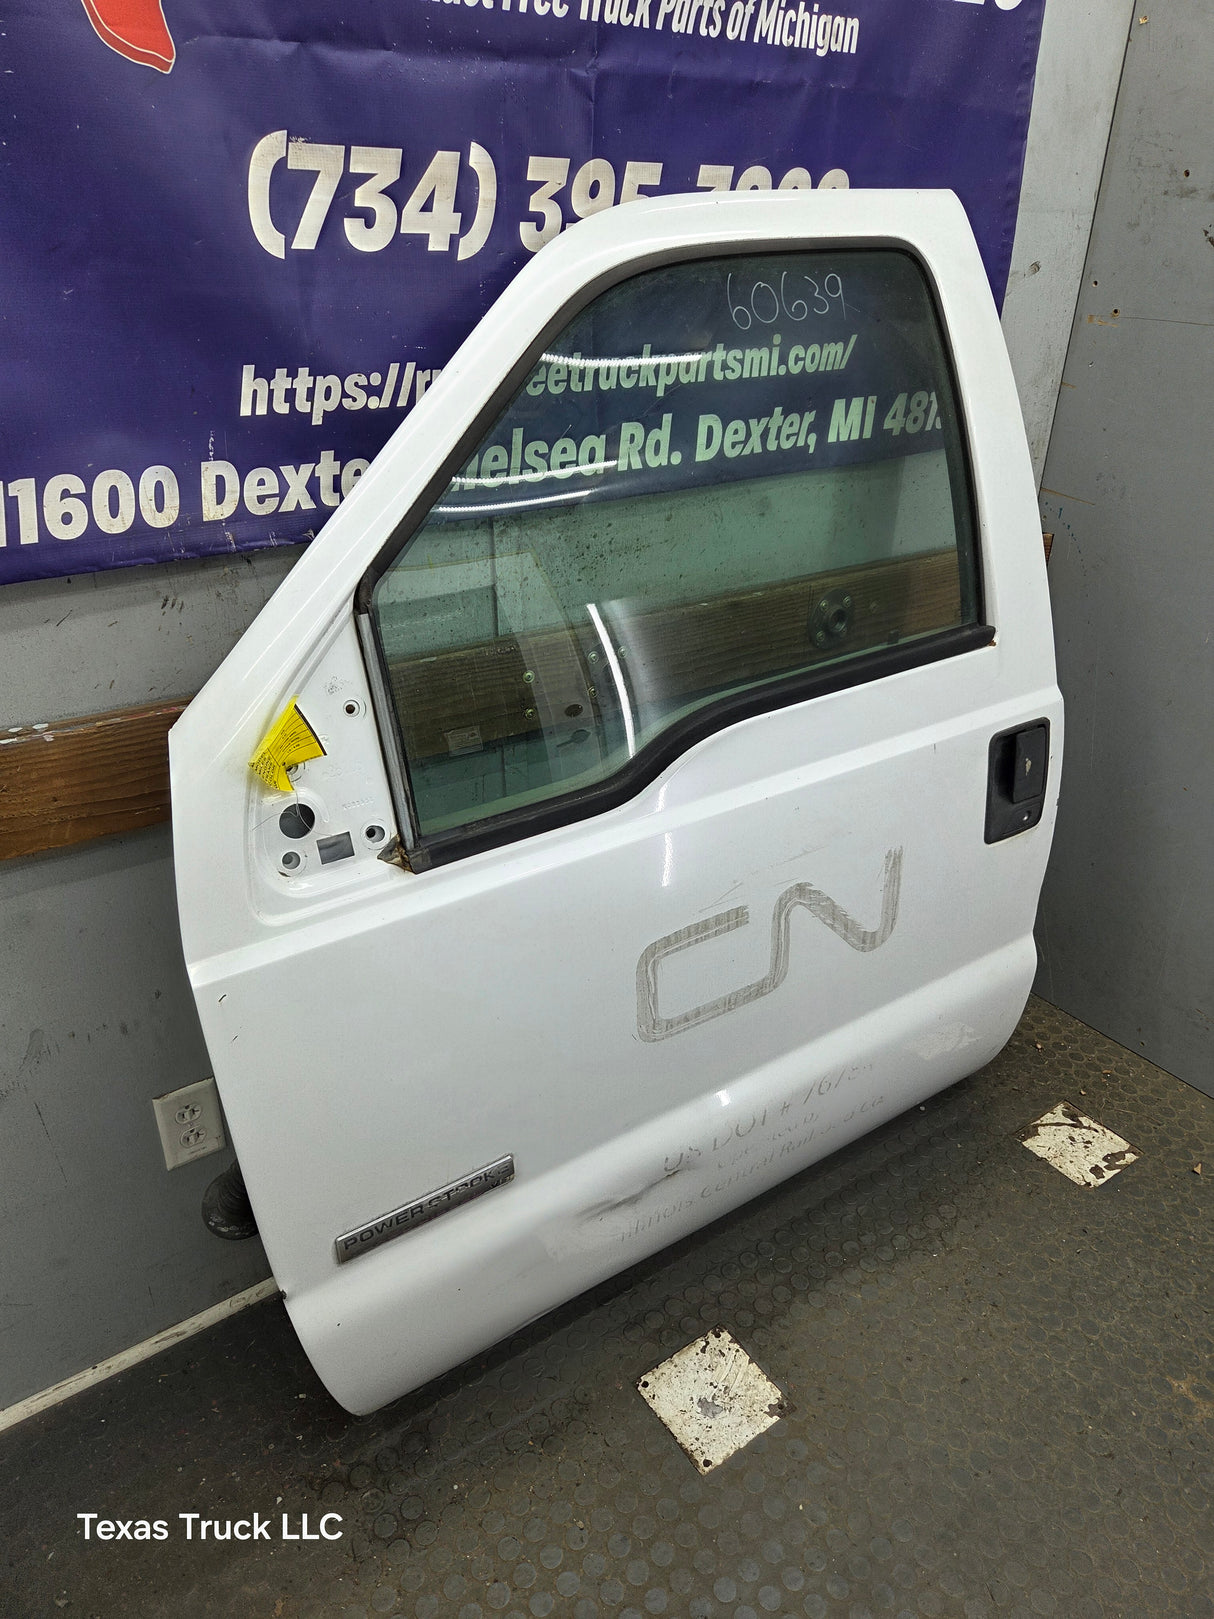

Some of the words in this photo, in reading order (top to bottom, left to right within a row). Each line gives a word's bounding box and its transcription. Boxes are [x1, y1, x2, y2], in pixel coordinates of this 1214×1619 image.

[753, 0, 859, 57] Michigan
[248, 130, 497, 260] (734)
[727, 272, 849, 329] 60639
[0, 465, 180, 547] 1600
[201, 450, 373, 522] Dexte
[617, 412, 682, 472] Rd.
[695, 405, 816, 462] Dexter,
[827, 396, 877, 443] MI
